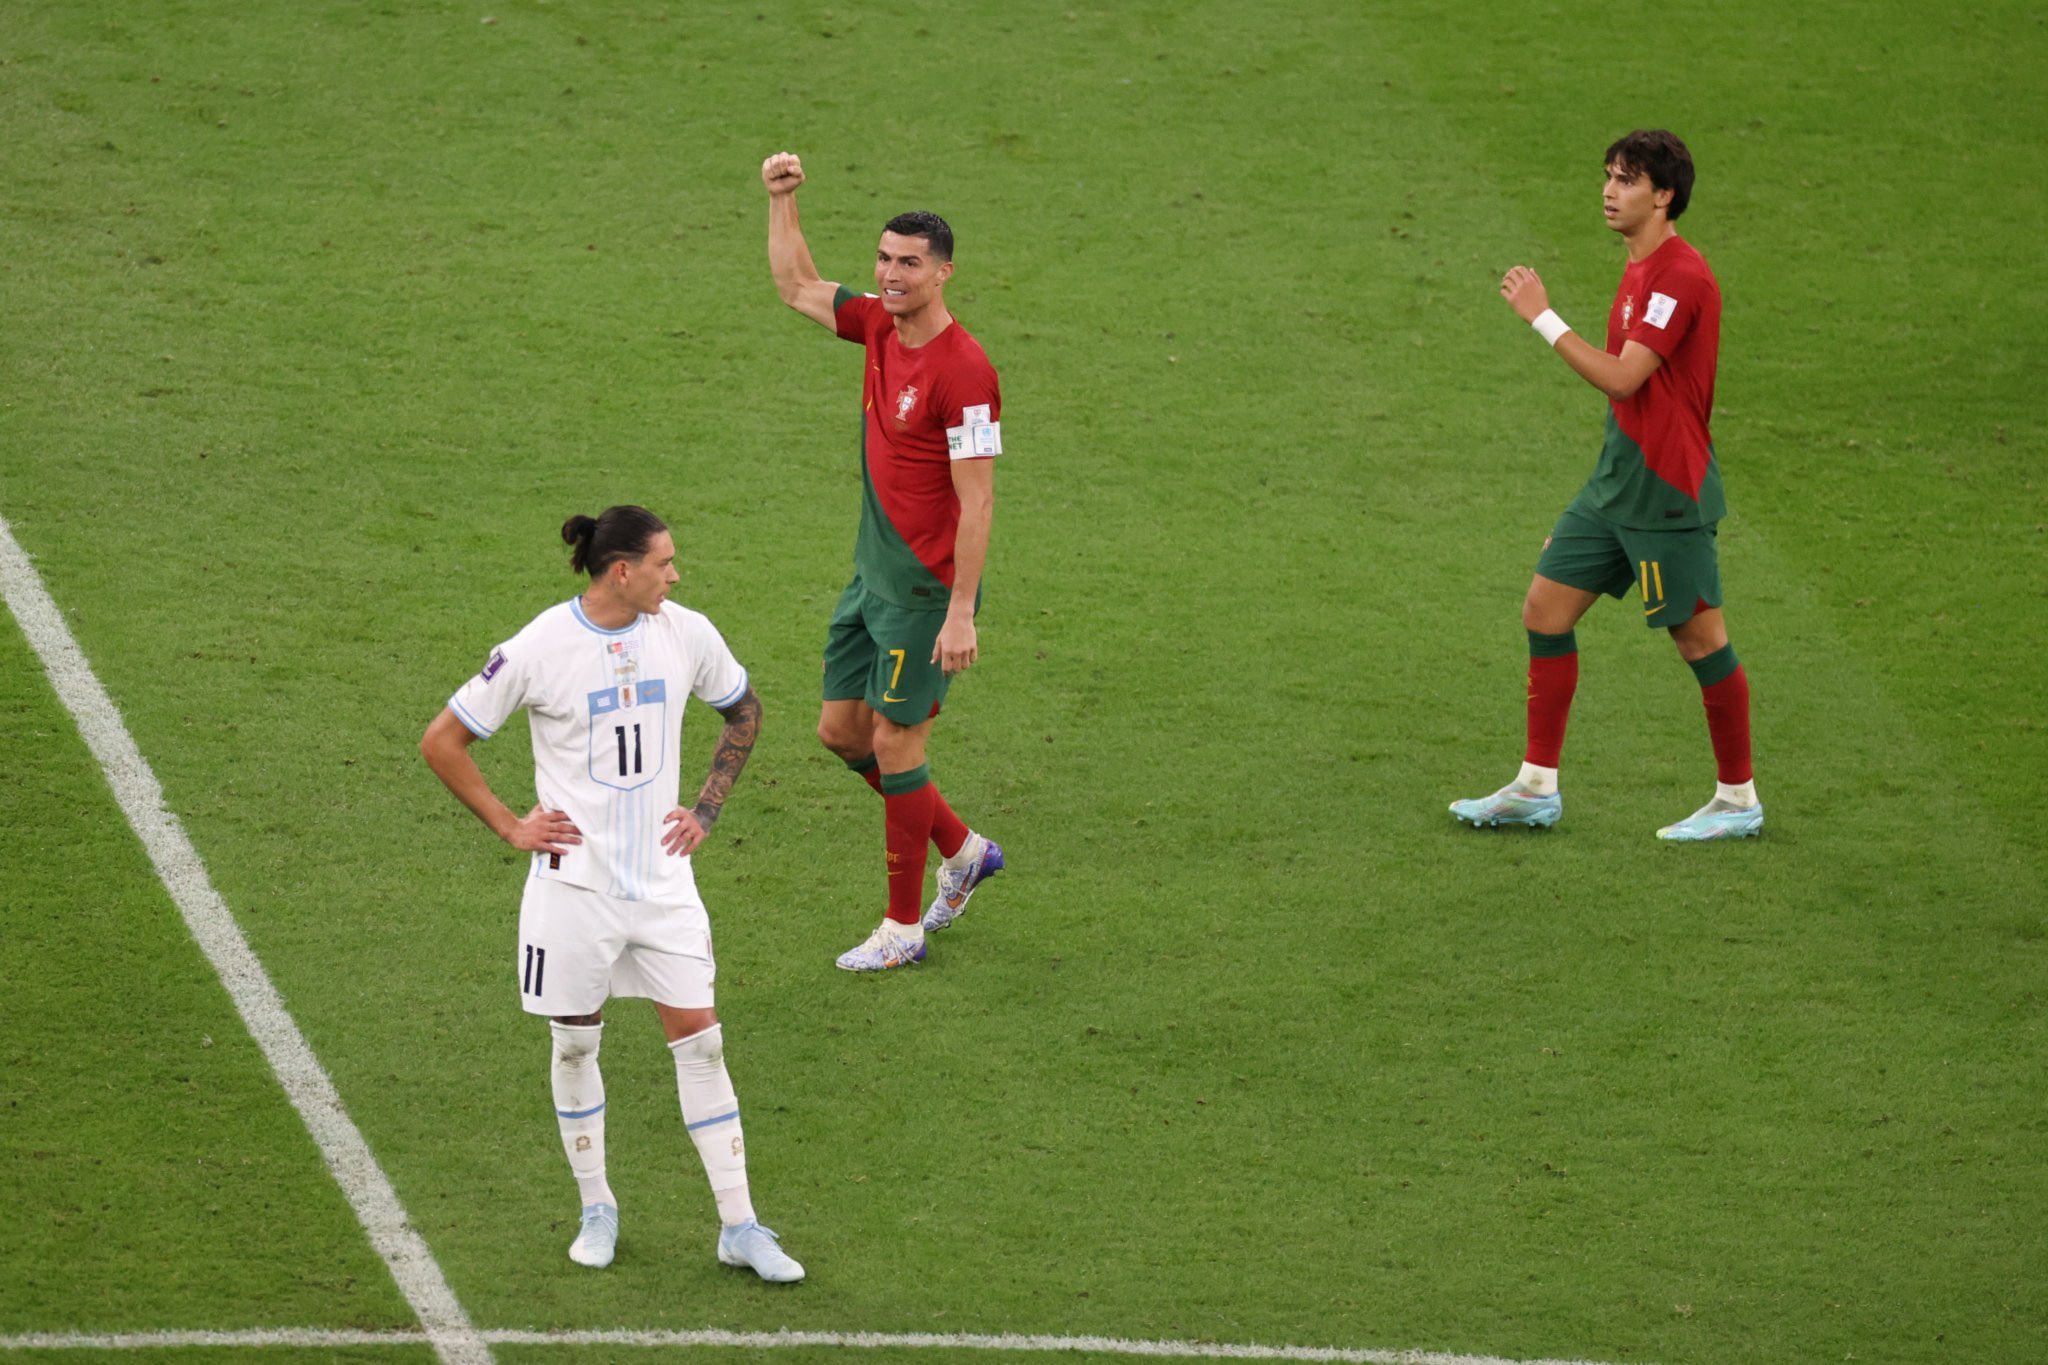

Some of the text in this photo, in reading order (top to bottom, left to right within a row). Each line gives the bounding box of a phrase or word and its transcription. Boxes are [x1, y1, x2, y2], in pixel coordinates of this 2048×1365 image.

[1639, 560, 1664, 602] 11
[889, 649, 905, 690] 7
[615, 723, 642, 776] 11
[523, 944, 545, 997] 11
